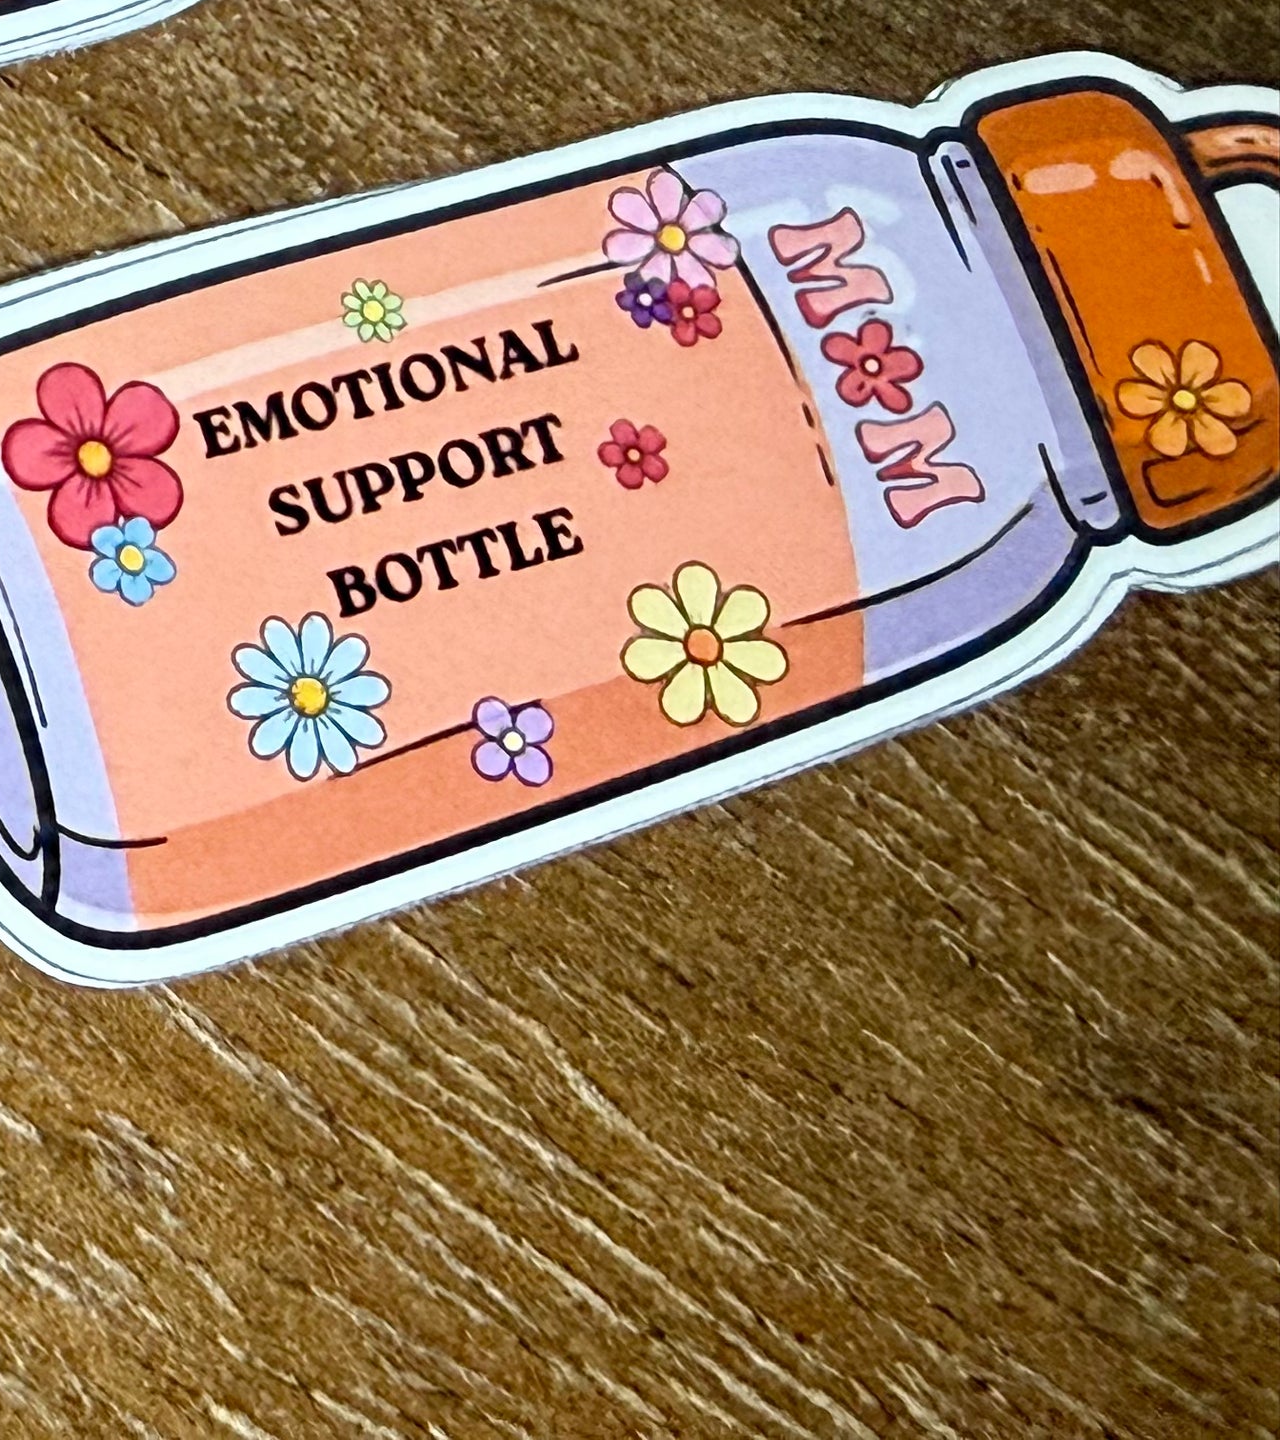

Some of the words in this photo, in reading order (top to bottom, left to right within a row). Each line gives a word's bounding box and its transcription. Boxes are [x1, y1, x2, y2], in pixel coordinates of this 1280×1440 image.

[191, 318, 581, 460] EMOTIONAL
[267, 412, 564, 537] SUPPORT
[325, 506, 585, 619] BOTTLE
